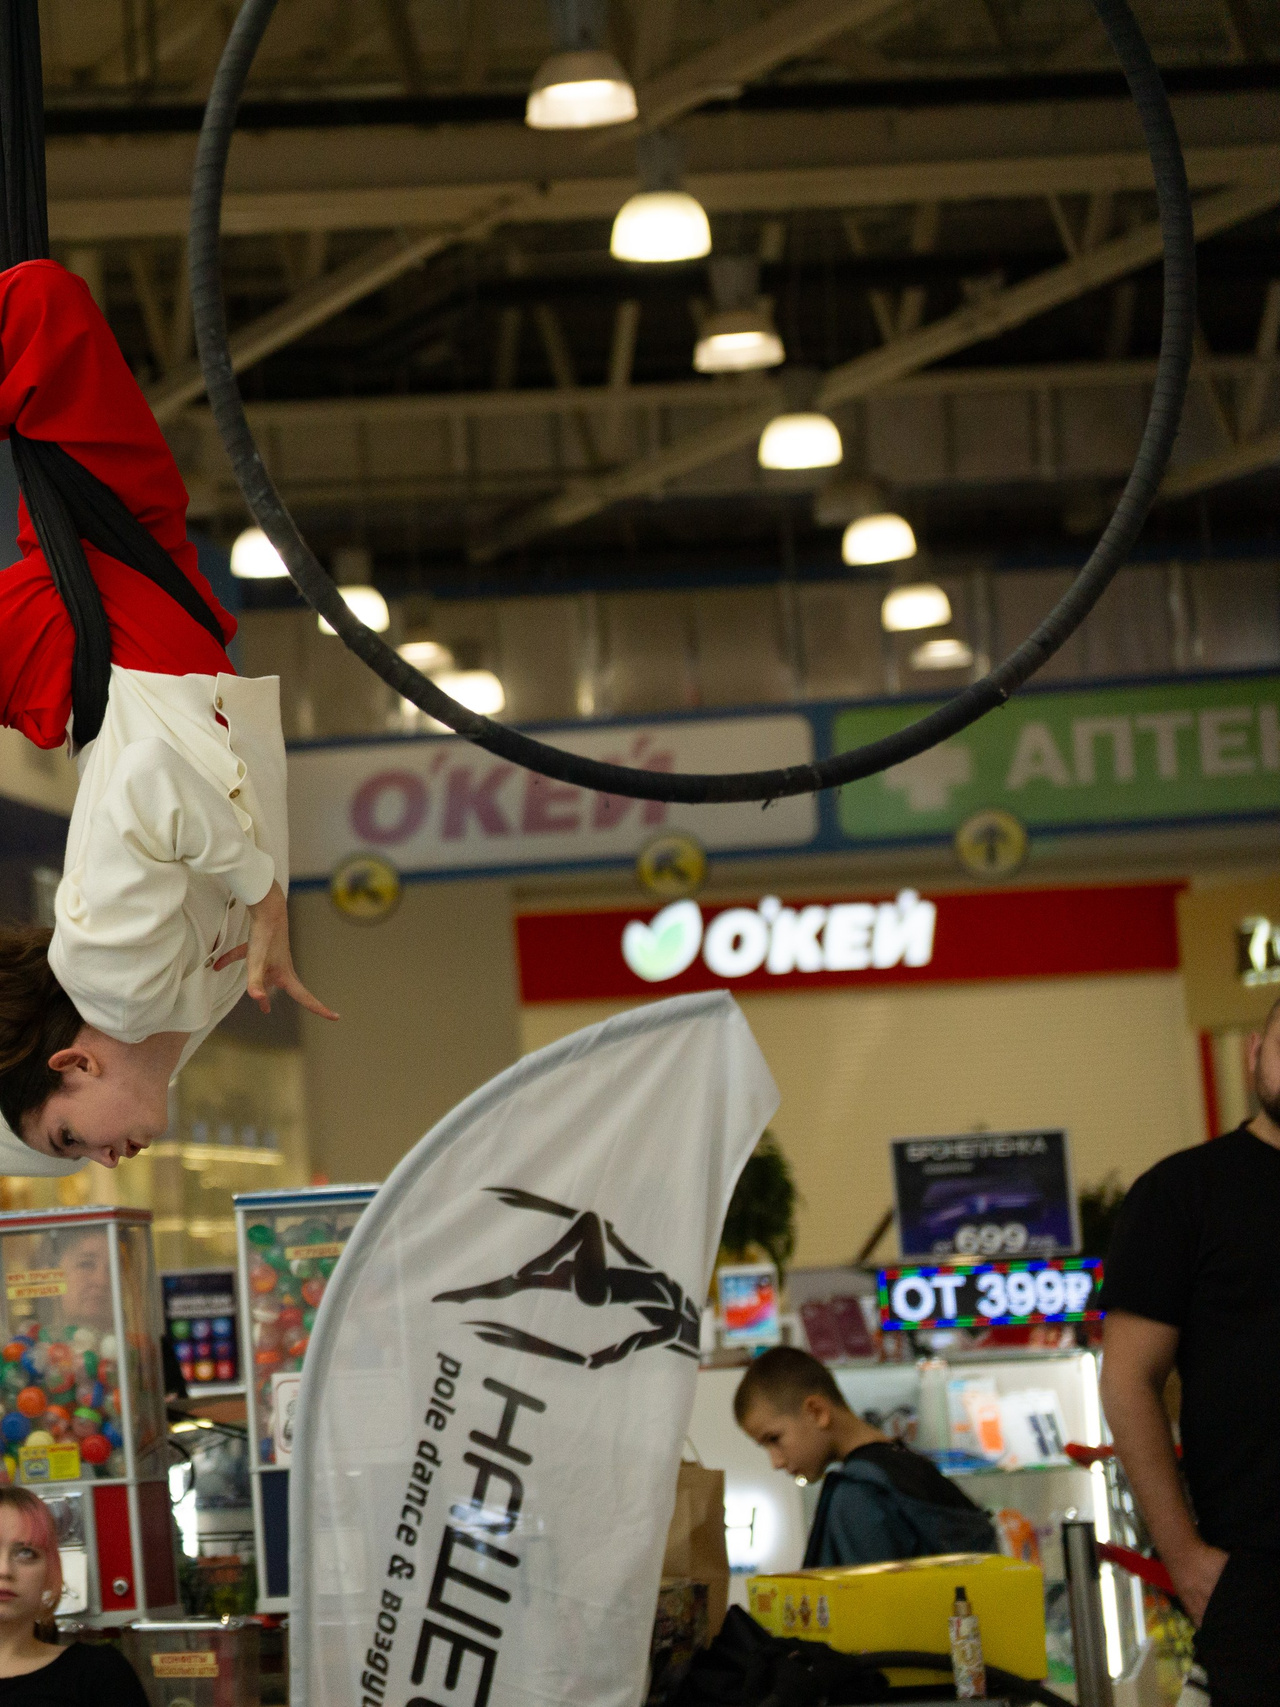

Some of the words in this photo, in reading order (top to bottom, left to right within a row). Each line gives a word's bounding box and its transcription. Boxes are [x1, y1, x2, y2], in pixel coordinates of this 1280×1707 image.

[955, 1223, 1028, 1255] 699
[891, 1276, 967, 1322] ОТ
[424, 1351, 463, 1432] pole
[395, 1439, 442, 1547] dance
[387, 1553, 416, 1581] &
[406, 1376, 548, 1707] НАШЕ
